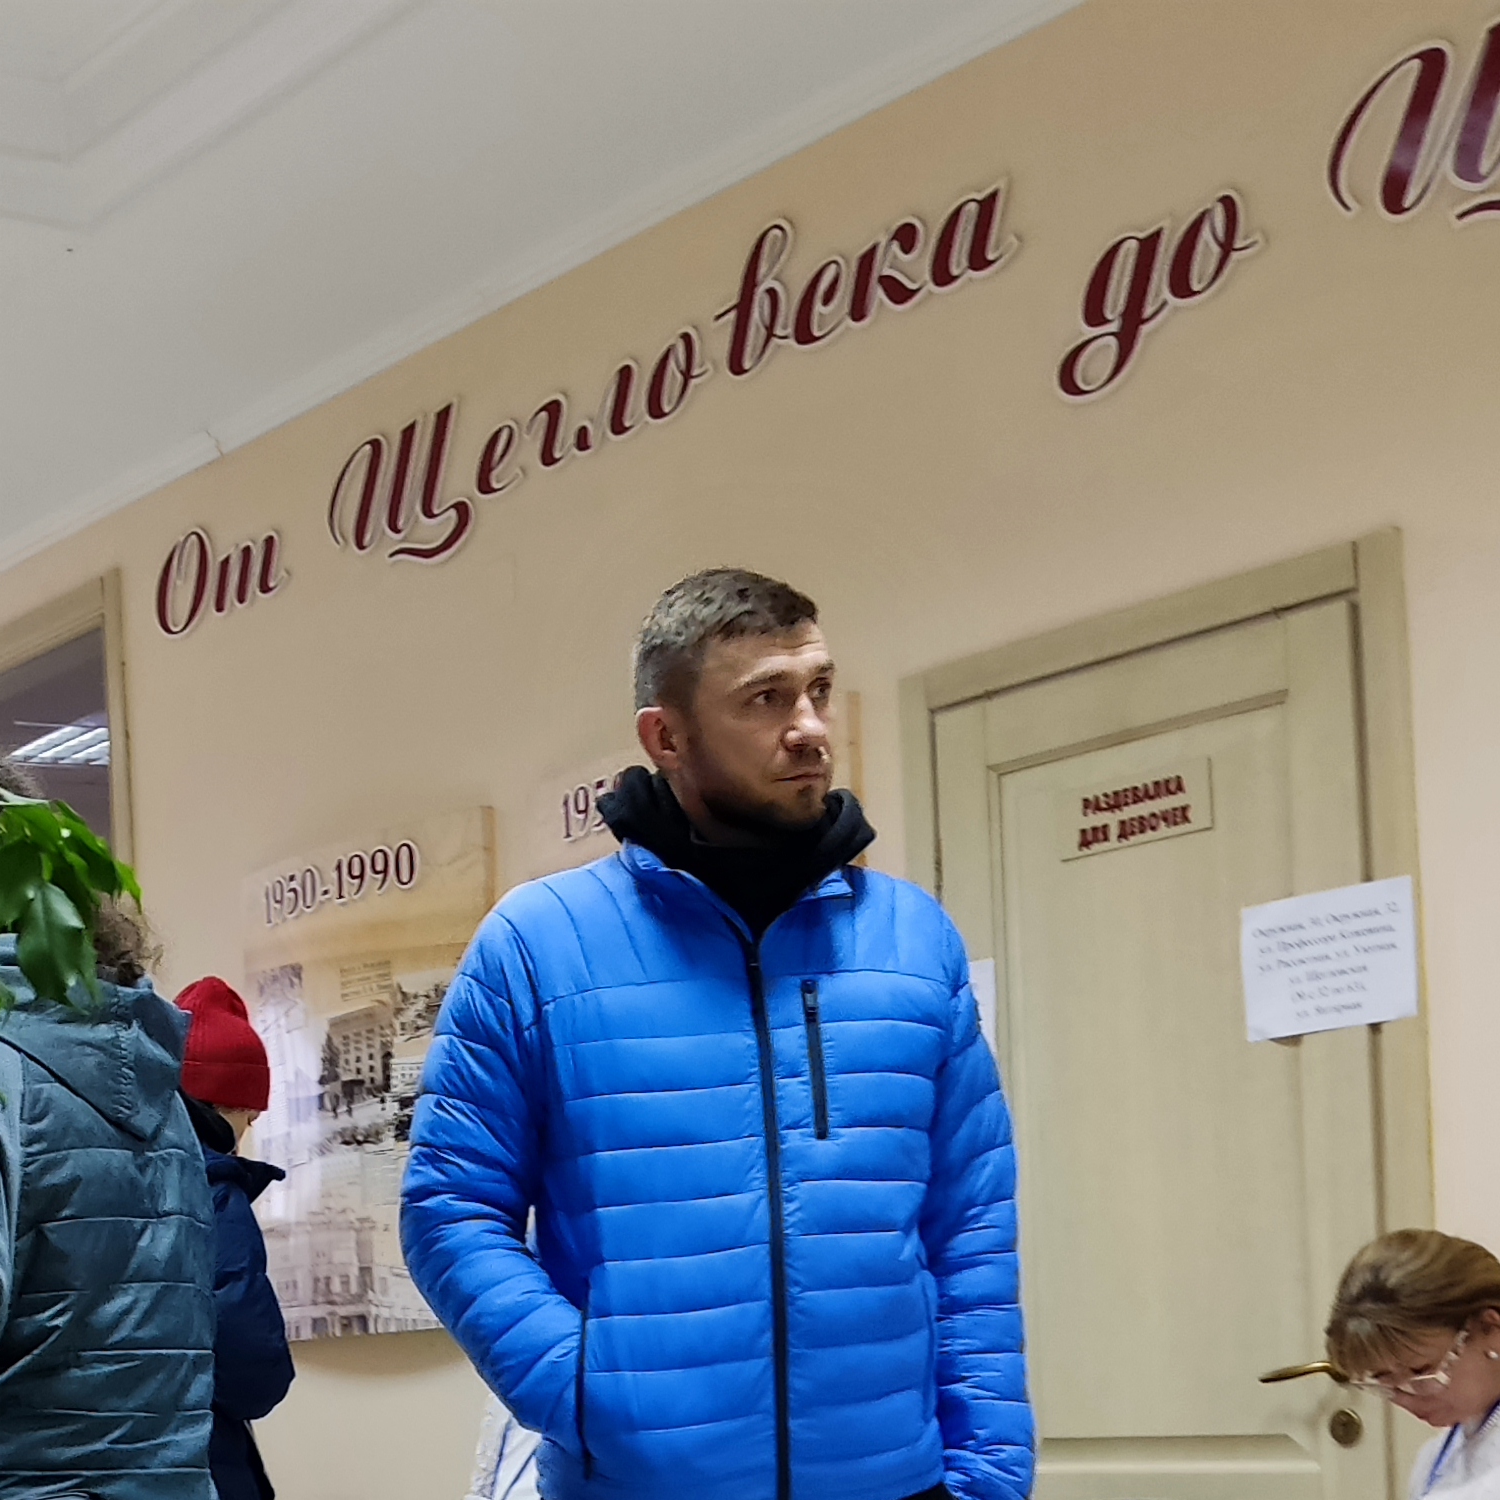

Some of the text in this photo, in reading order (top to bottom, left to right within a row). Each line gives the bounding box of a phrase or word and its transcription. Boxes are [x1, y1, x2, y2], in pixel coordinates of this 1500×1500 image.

[155, 530, 282, 636] От
[1056, 193, 1260, 398] до
[1078, 804, 1192, 851] ДЛЯ ДЕВОЧЕК
[1082, 775, 1186, 816] РАЗДЕВАЛКА
[264, 842, 416, 924] 1950-1990
